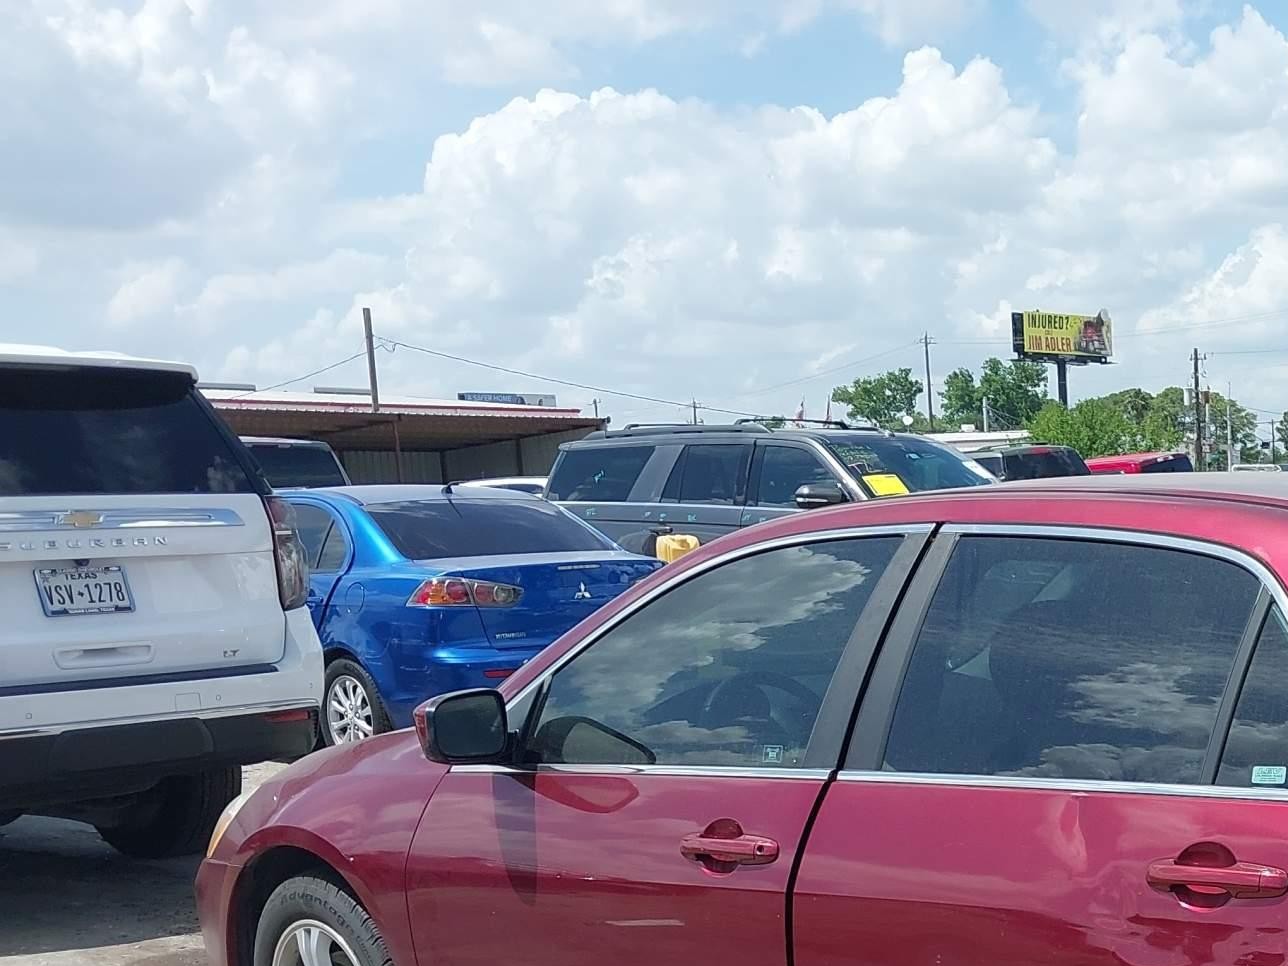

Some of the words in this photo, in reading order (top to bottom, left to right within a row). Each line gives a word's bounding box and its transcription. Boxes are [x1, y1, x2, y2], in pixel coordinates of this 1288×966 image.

[1027, 313, 1070, 330] INJURED?
[1028, 335, 1043, 351] JIM
[1045, 336, 1072, 352] ADLER
[44, 584, 74, 605] VSV
[84, 582, 126, 603] 1278
